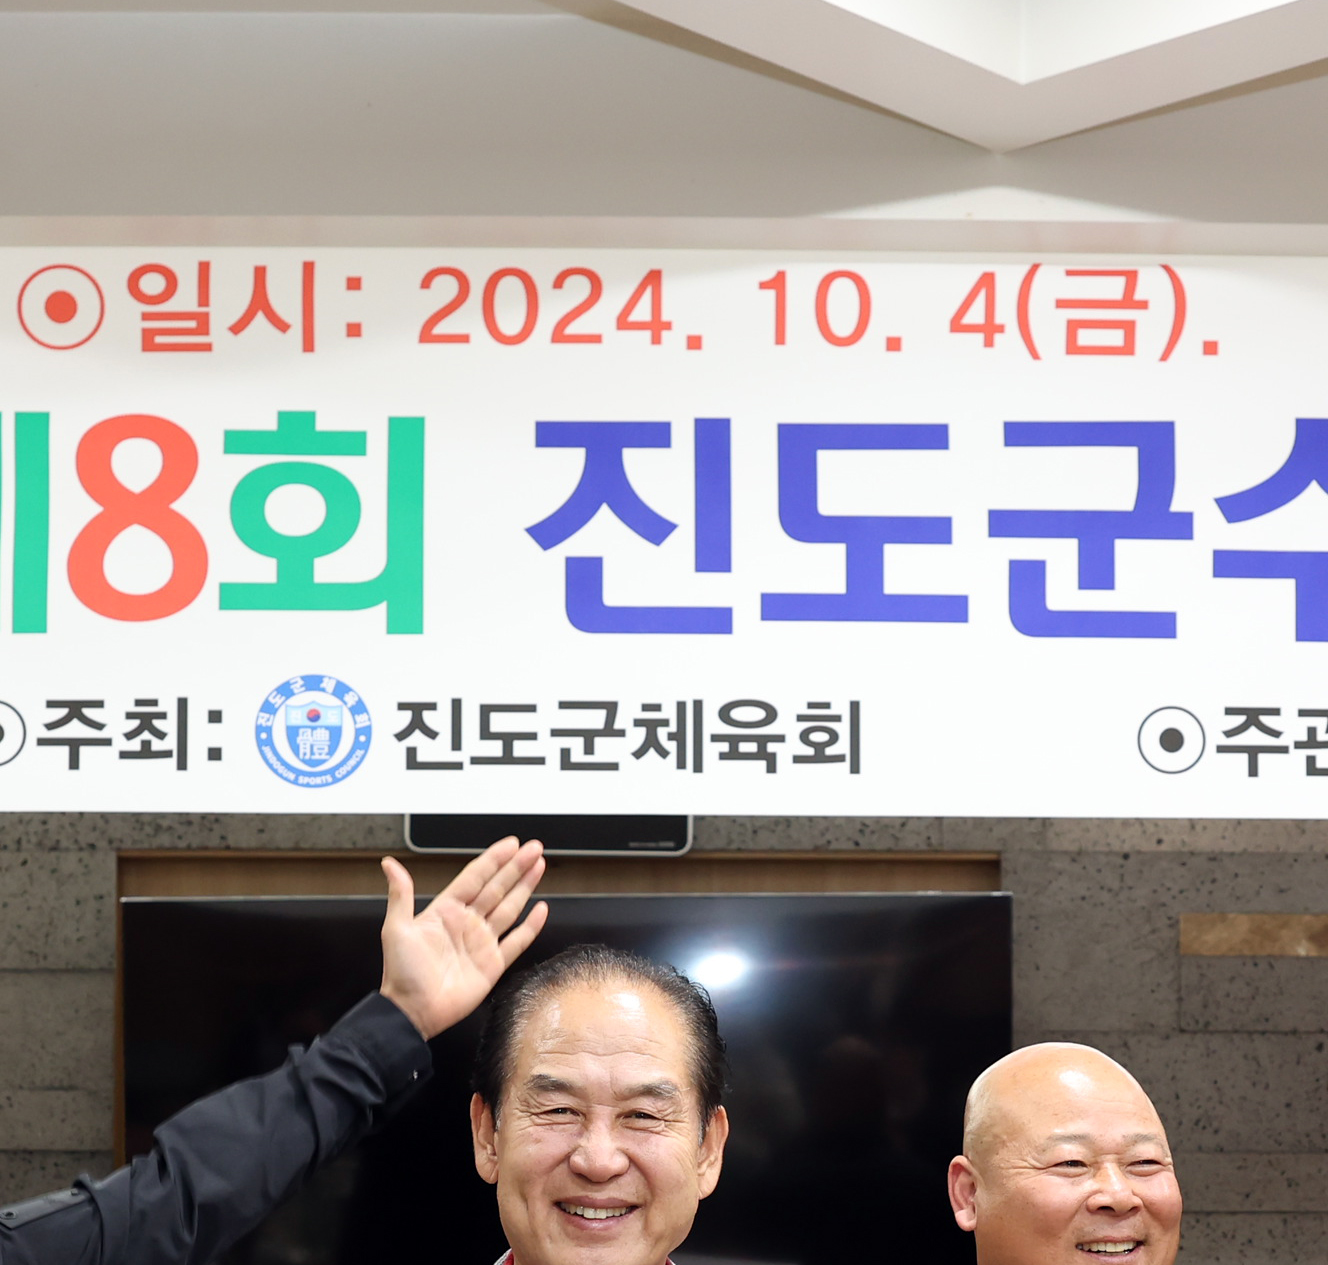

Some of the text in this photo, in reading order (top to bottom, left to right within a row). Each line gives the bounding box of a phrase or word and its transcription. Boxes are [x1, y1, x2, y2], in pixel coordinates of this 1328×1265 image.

[126, 260, 1219, 362] 일시: 2024. 10. 4(금).
[36, 696, 861, 775] 주최: 진도군체육회
[297, 774, 334, 785] SPORTS
[335, 749, 366, 778] COUNCIL
